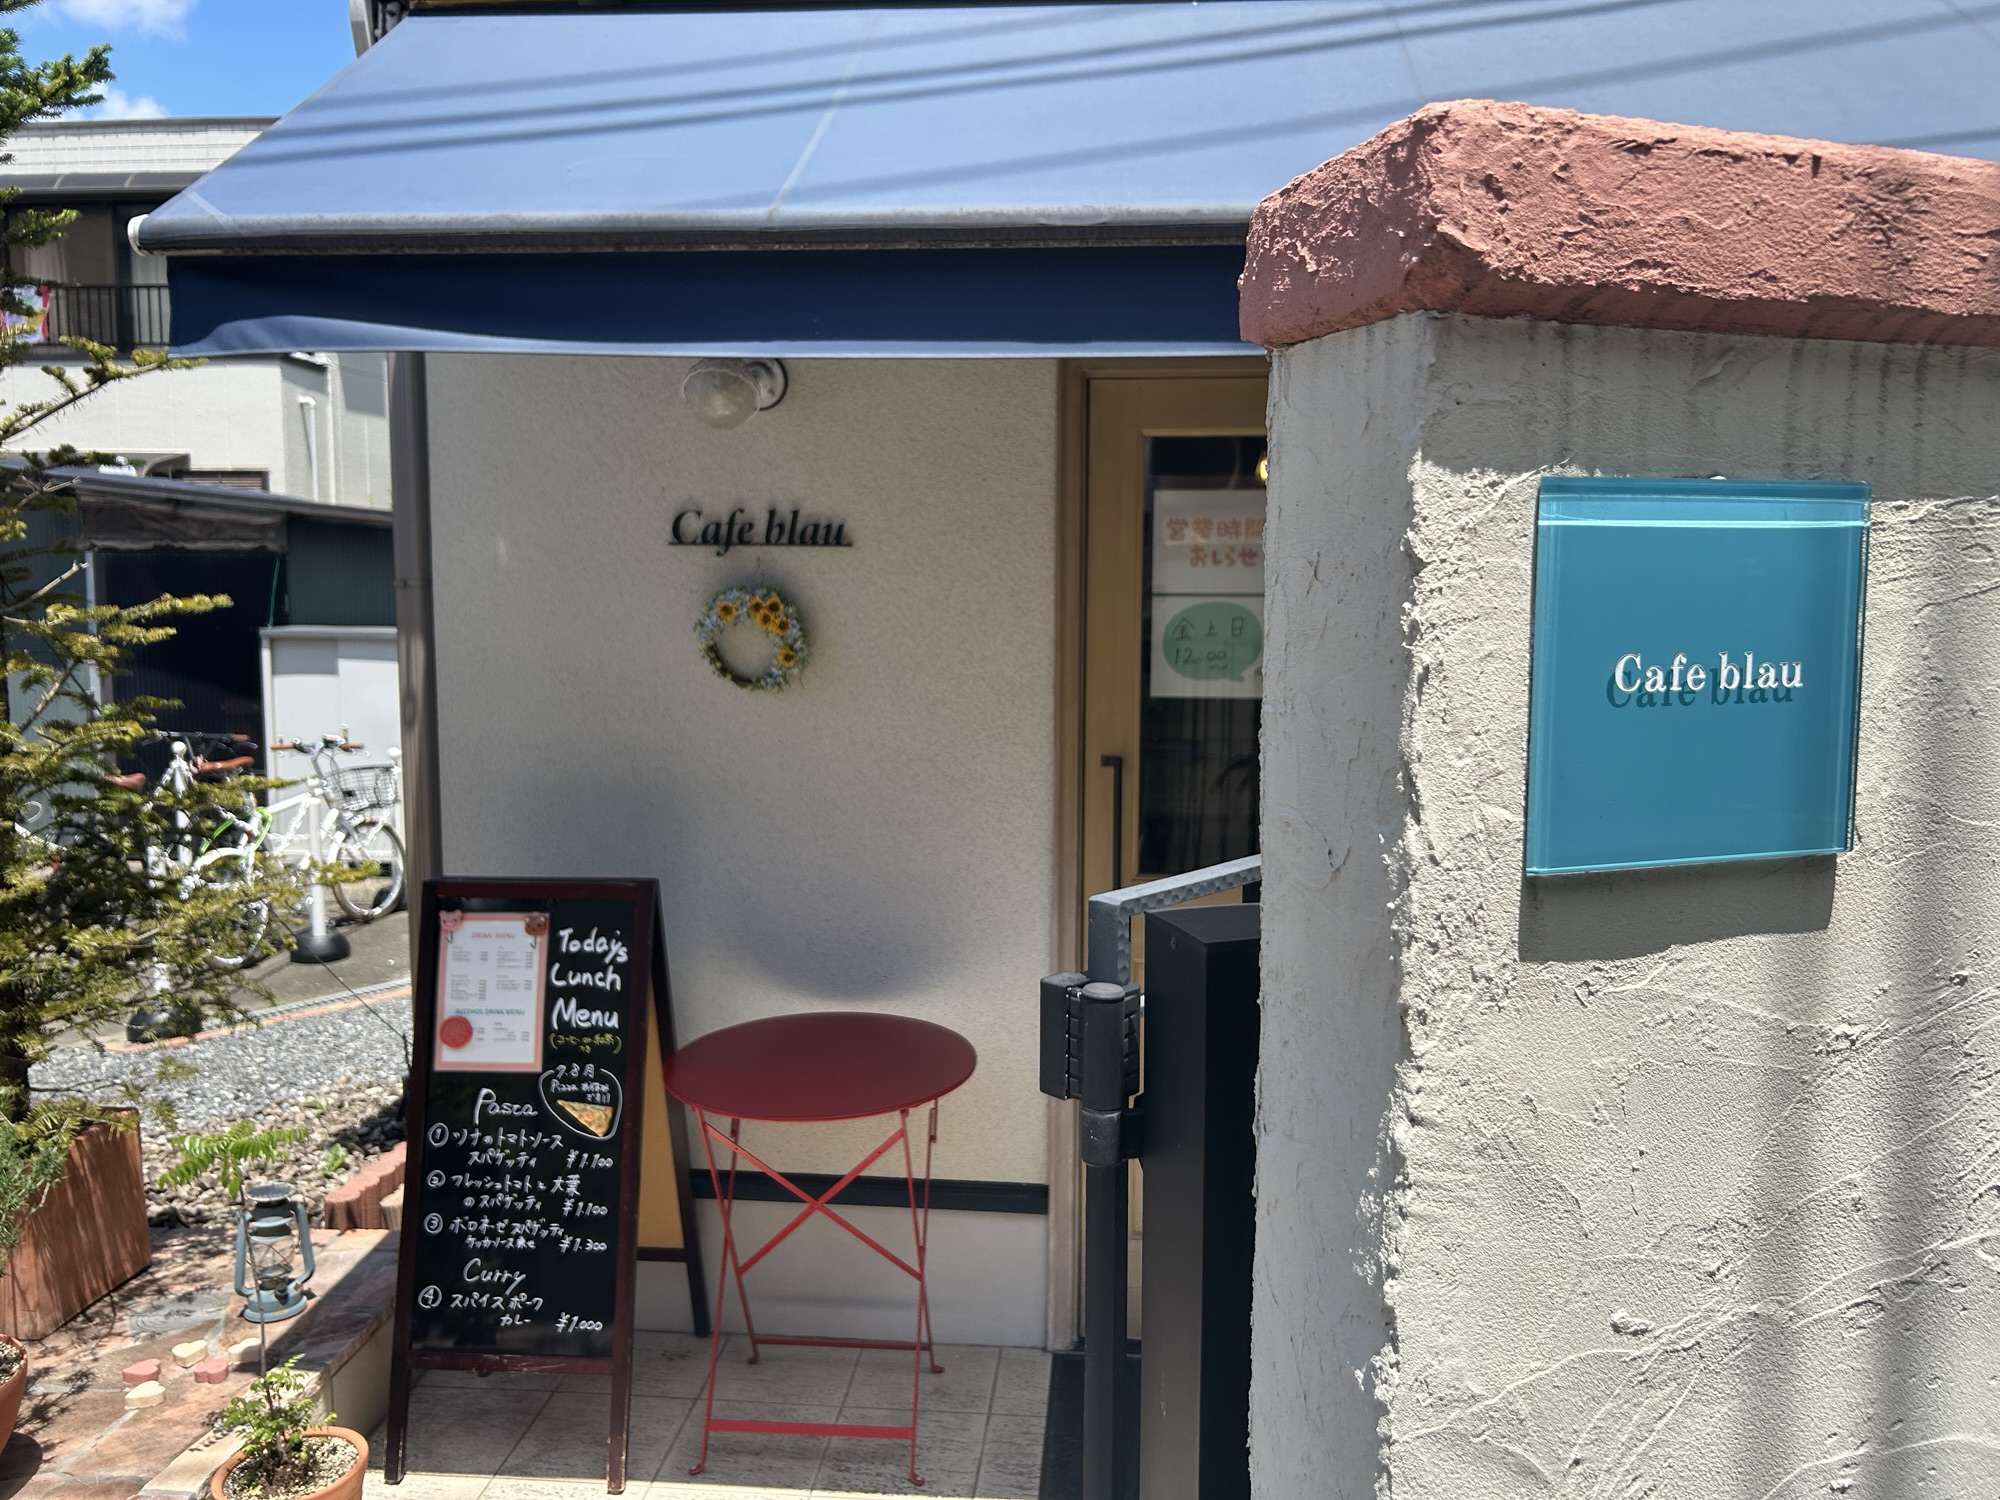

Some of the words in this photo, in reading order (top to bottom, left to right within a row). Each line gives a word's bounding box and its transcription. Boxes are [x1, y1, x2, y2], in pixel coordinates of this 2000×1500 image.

[672, 508, 754, 556] Cafe
[765, 509, 845, 546] blau
[1166, 517, 1266, 543] 営業時間
[1189, 546, 1258, 568] おしらせ
[1614, 652, 1706, 692] Cafe
[1718, 651, 1803, 689] blau
[550, 961, 621, 991] Lunch
[551, 996, 619, 1030] Menu
[551, 1078, 578, 1093] Pizza
[473, 1087, 539, 1126] Pasta
[452, 1127, 564, 1150] ツナのトマトソース
[467, 1148, 537, 1169] スパゲッティ
[463, 1258, 526, 1295] Curry
[450, 1292, 544, 1311] スパイスポーク
[500, 1314, 531, 1327] カレー
